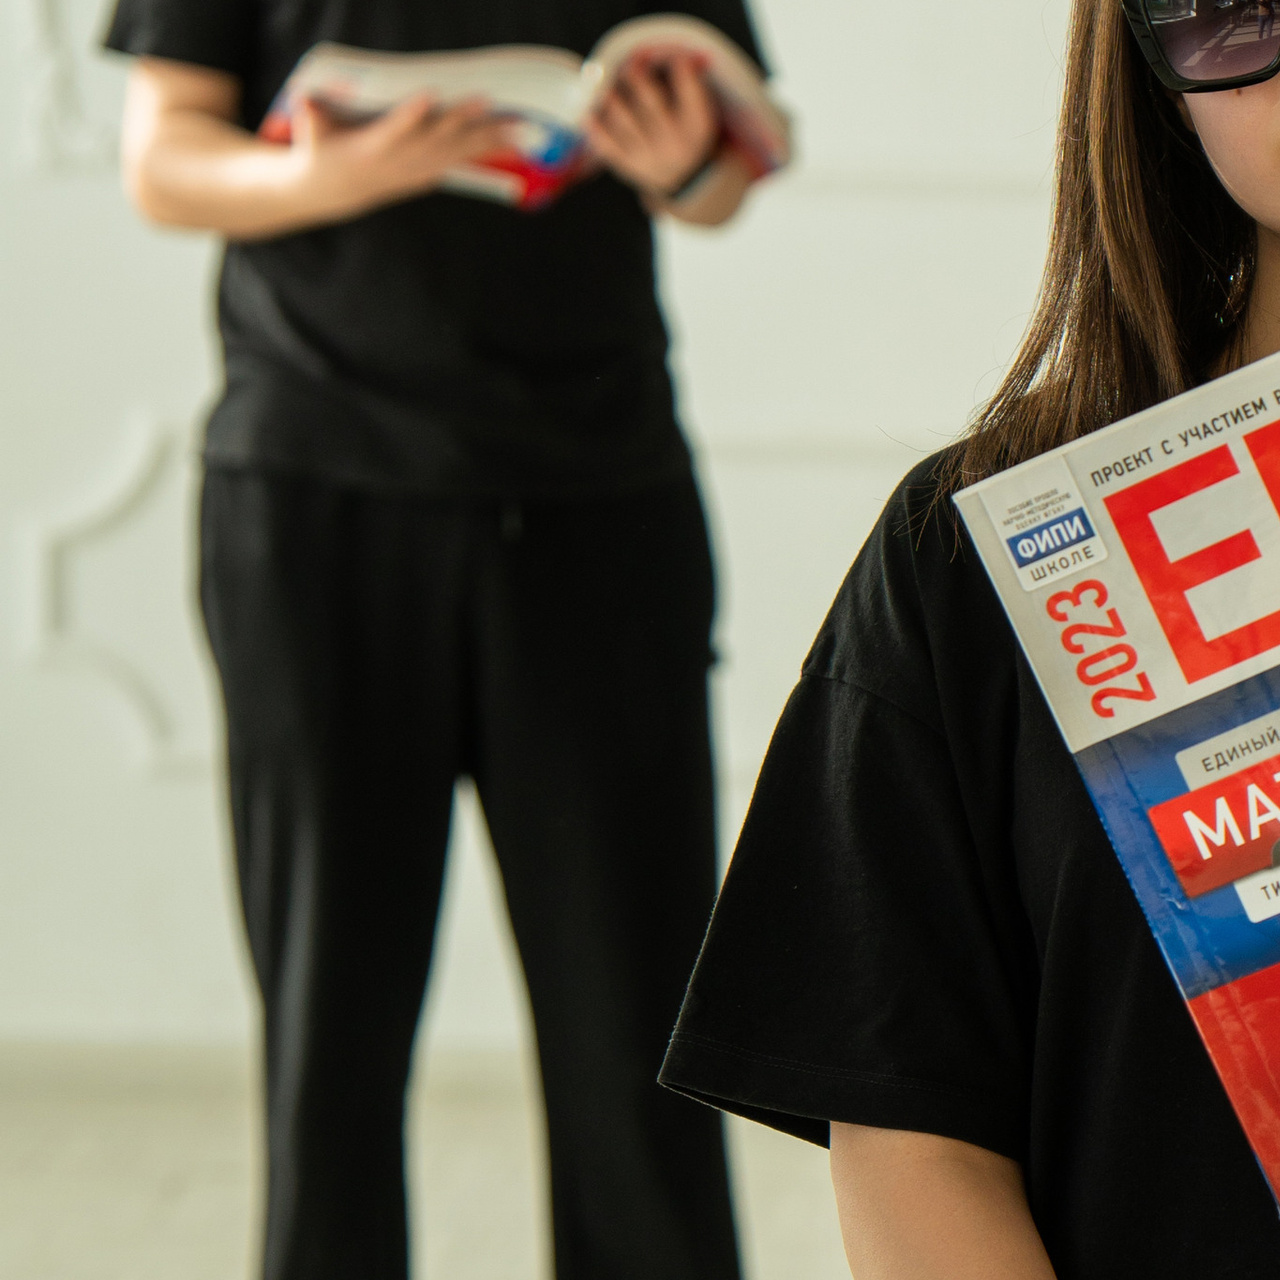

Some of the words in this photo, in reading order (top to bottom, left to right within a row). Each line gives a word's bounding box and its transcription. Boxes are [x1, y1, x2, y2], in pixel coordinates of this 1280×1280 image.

[1090, 446, 1155, 487] ПРОЕКТ
[1179, 397, 1268, 448] УЧАСТИЕМ
[1017, 515, 1086, 559] ФИПИ
[1030, 545, 1094, 581] ШКОЛЕ
[1045, 579, 1157, 719] 2023
[1201, 726, 1280, 773] ЕДИНЫЙ
